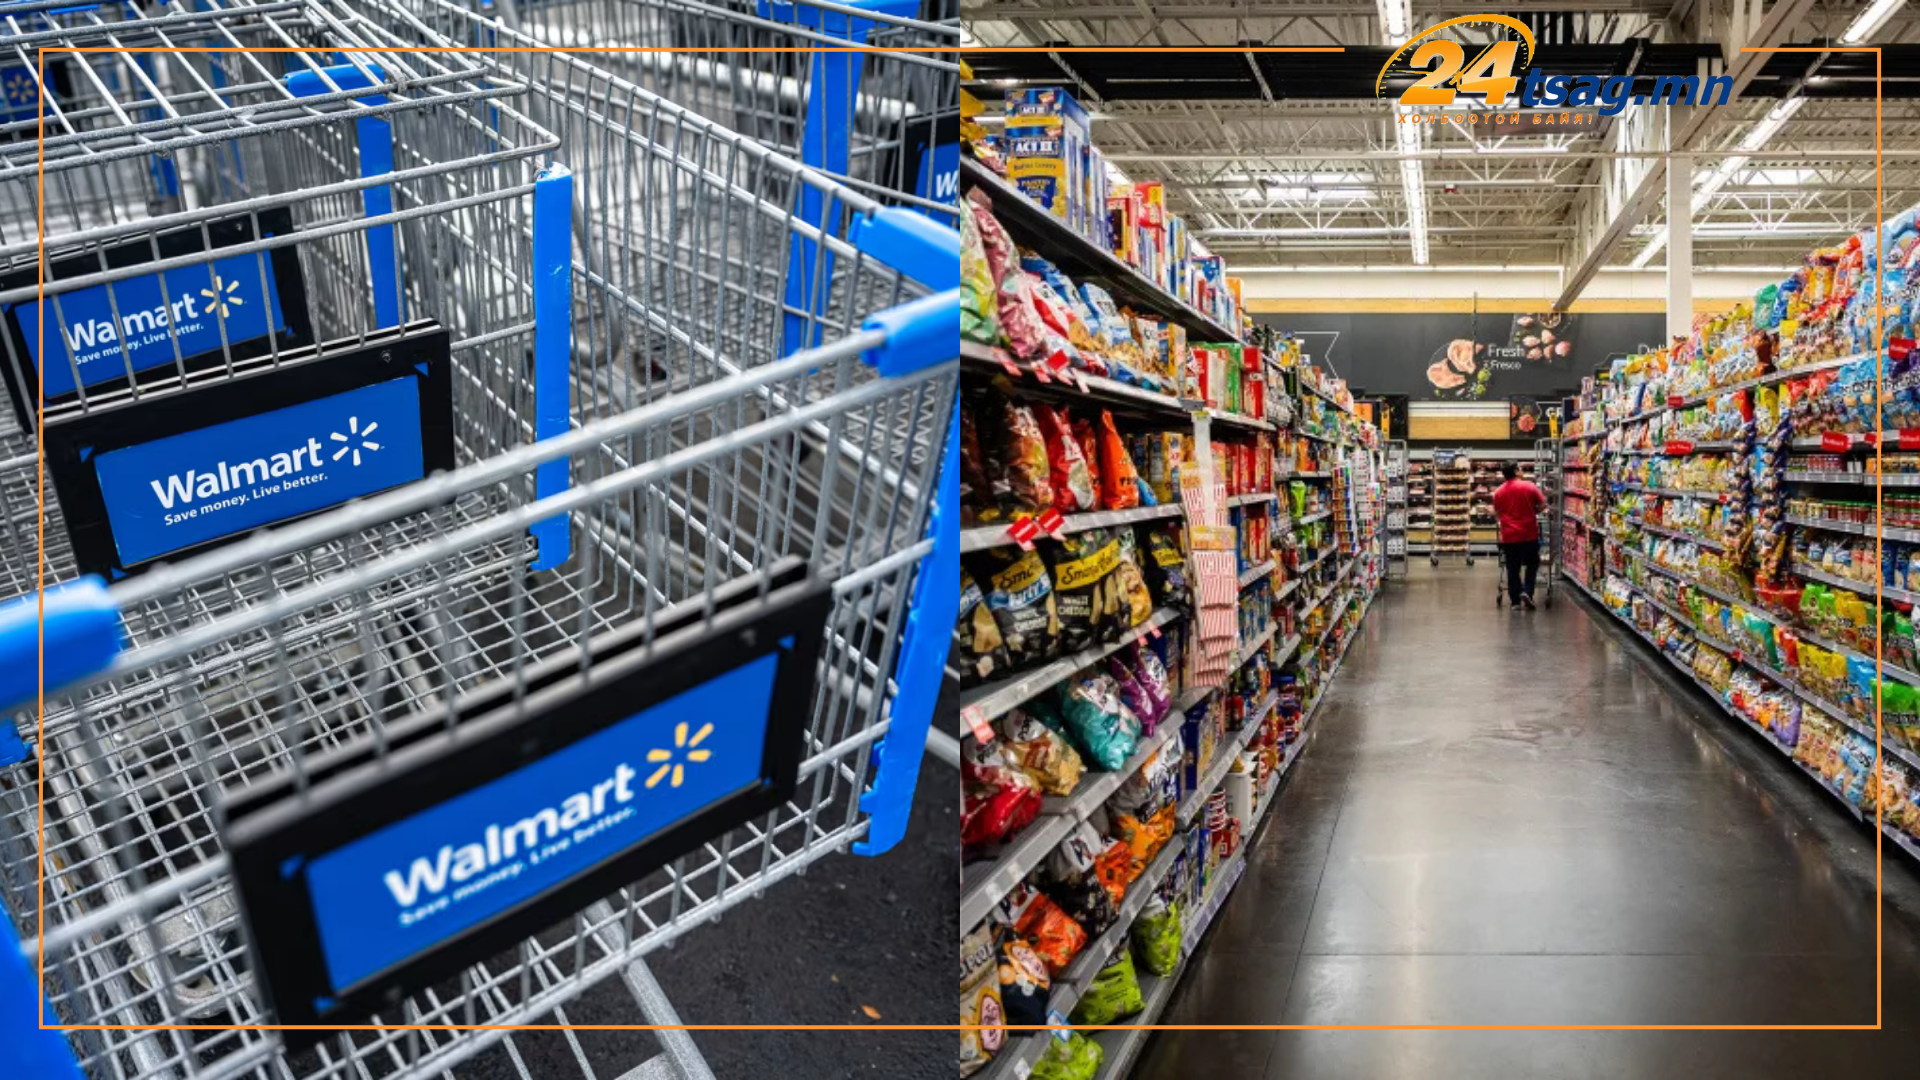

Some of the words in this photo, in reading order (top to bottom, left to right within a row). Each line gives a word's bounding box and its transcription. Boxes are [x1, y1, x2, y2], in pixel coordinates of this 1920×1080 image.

[1015, 141, 1038, 152] ACT
[74, 351, 101, 365] Save
[143, 332, 166, 345] Live
[1488, 344, 1526, 357] Fresh
[1490, 360, 1522, 370] Fresco
[150, 437, 324, 510] Walmart
[164, 509, 198, 527] Save
[200, 494, 251, 515] money.
[252, 484, 282, 500] Live
[282, 472, 328, 491] better.
[383, 763, 636, 907] Walmart
[399, 896, 450, 928] Save
[452, 860, 528, 902] money.
[529, 836, 571, 866] Live
